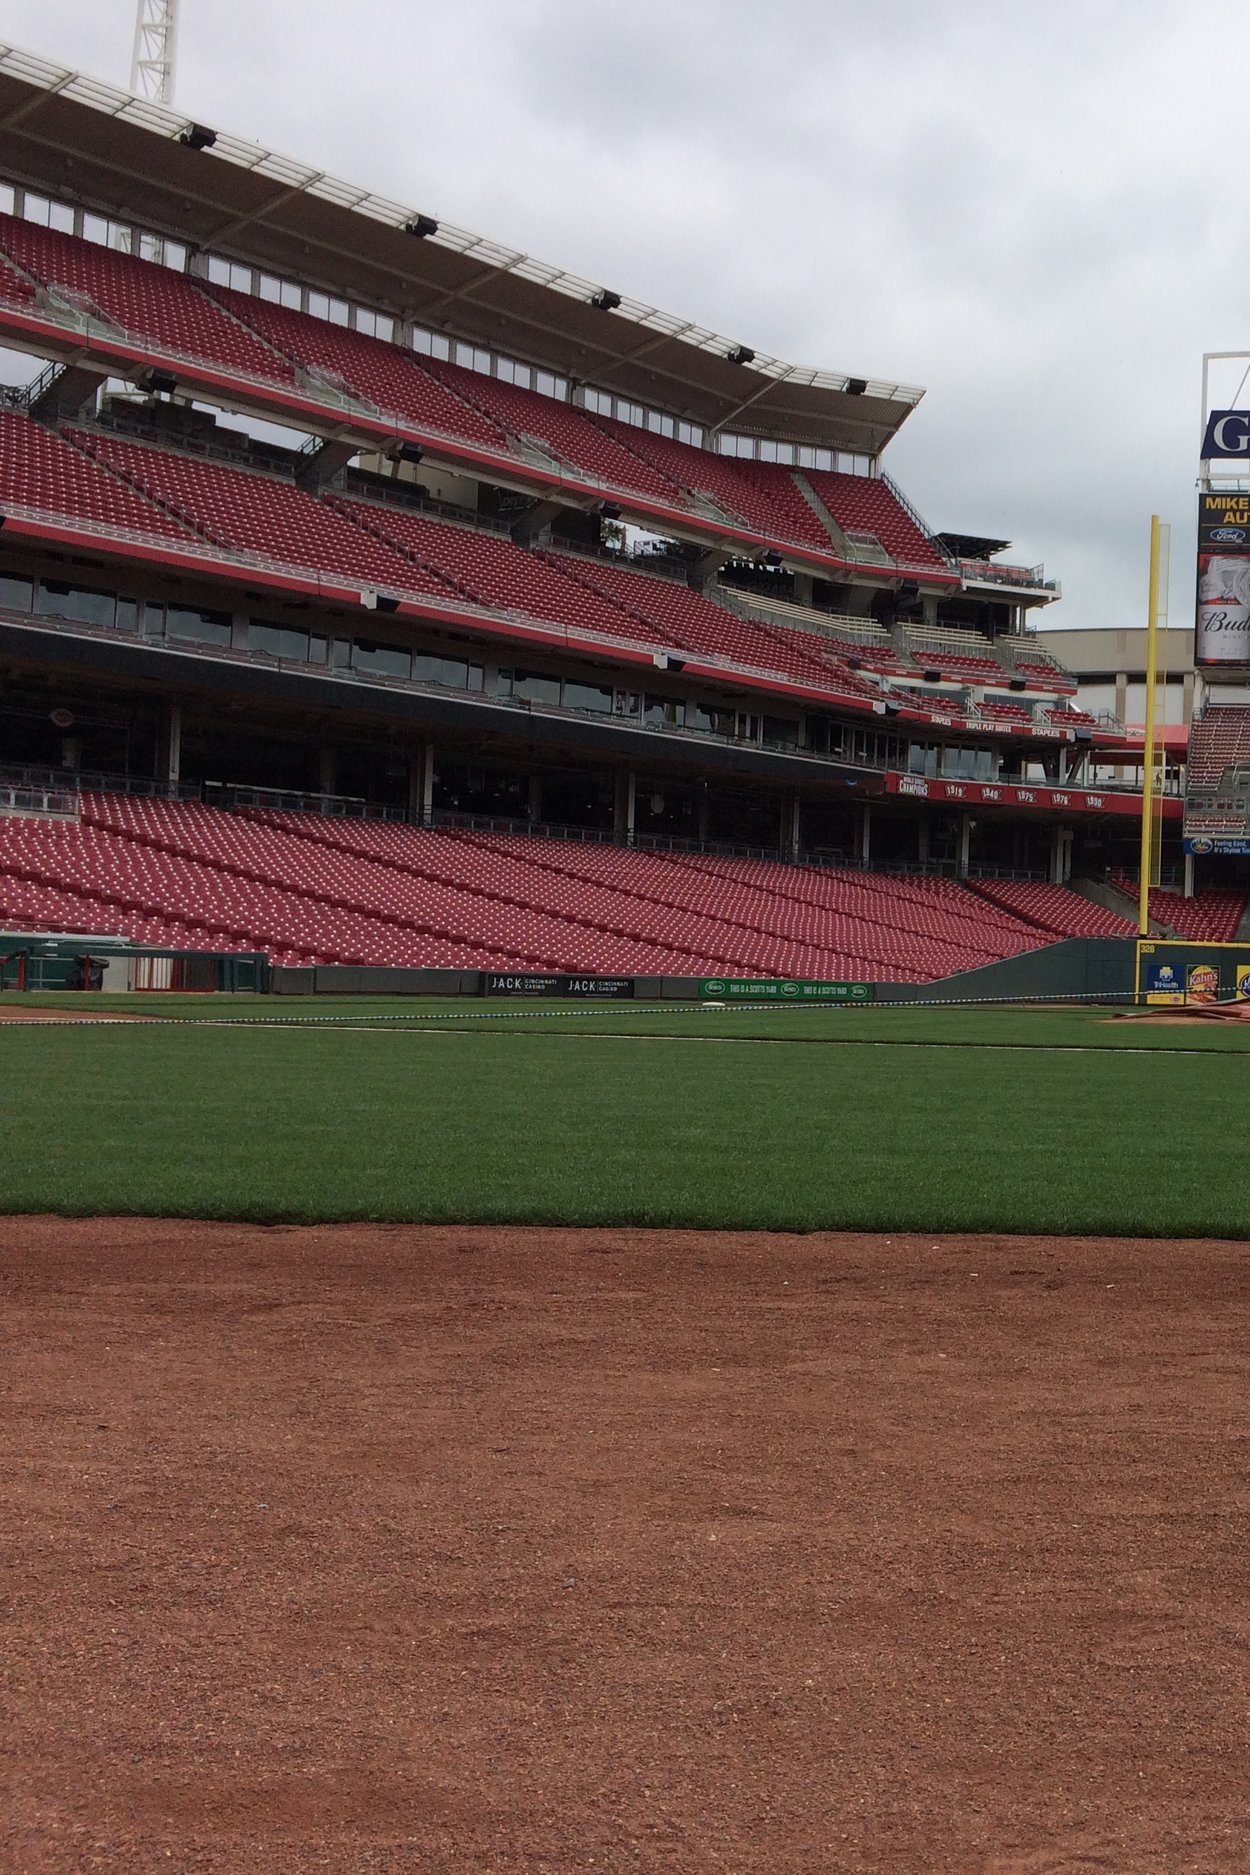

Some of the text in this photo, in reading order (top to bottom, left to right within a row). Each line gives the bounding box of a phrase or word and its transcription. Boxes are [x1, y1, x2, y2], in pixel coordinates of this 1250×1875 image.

[1205, 497, 1249, 510] MIKE
[1215, 528, 1238, 541] Ford
[930, 714, 952, 727] STAPLES
[983, 723, 995, 732] PLAY
[1031, 726, 1061, 738] STAPLES
[491, 976, 522, 989] JACK
[1153, 980, 1179, 989] TriHealth
[1188, 971, 1218, 986] Kahn's
[568, 979, 596, 992] JACK
